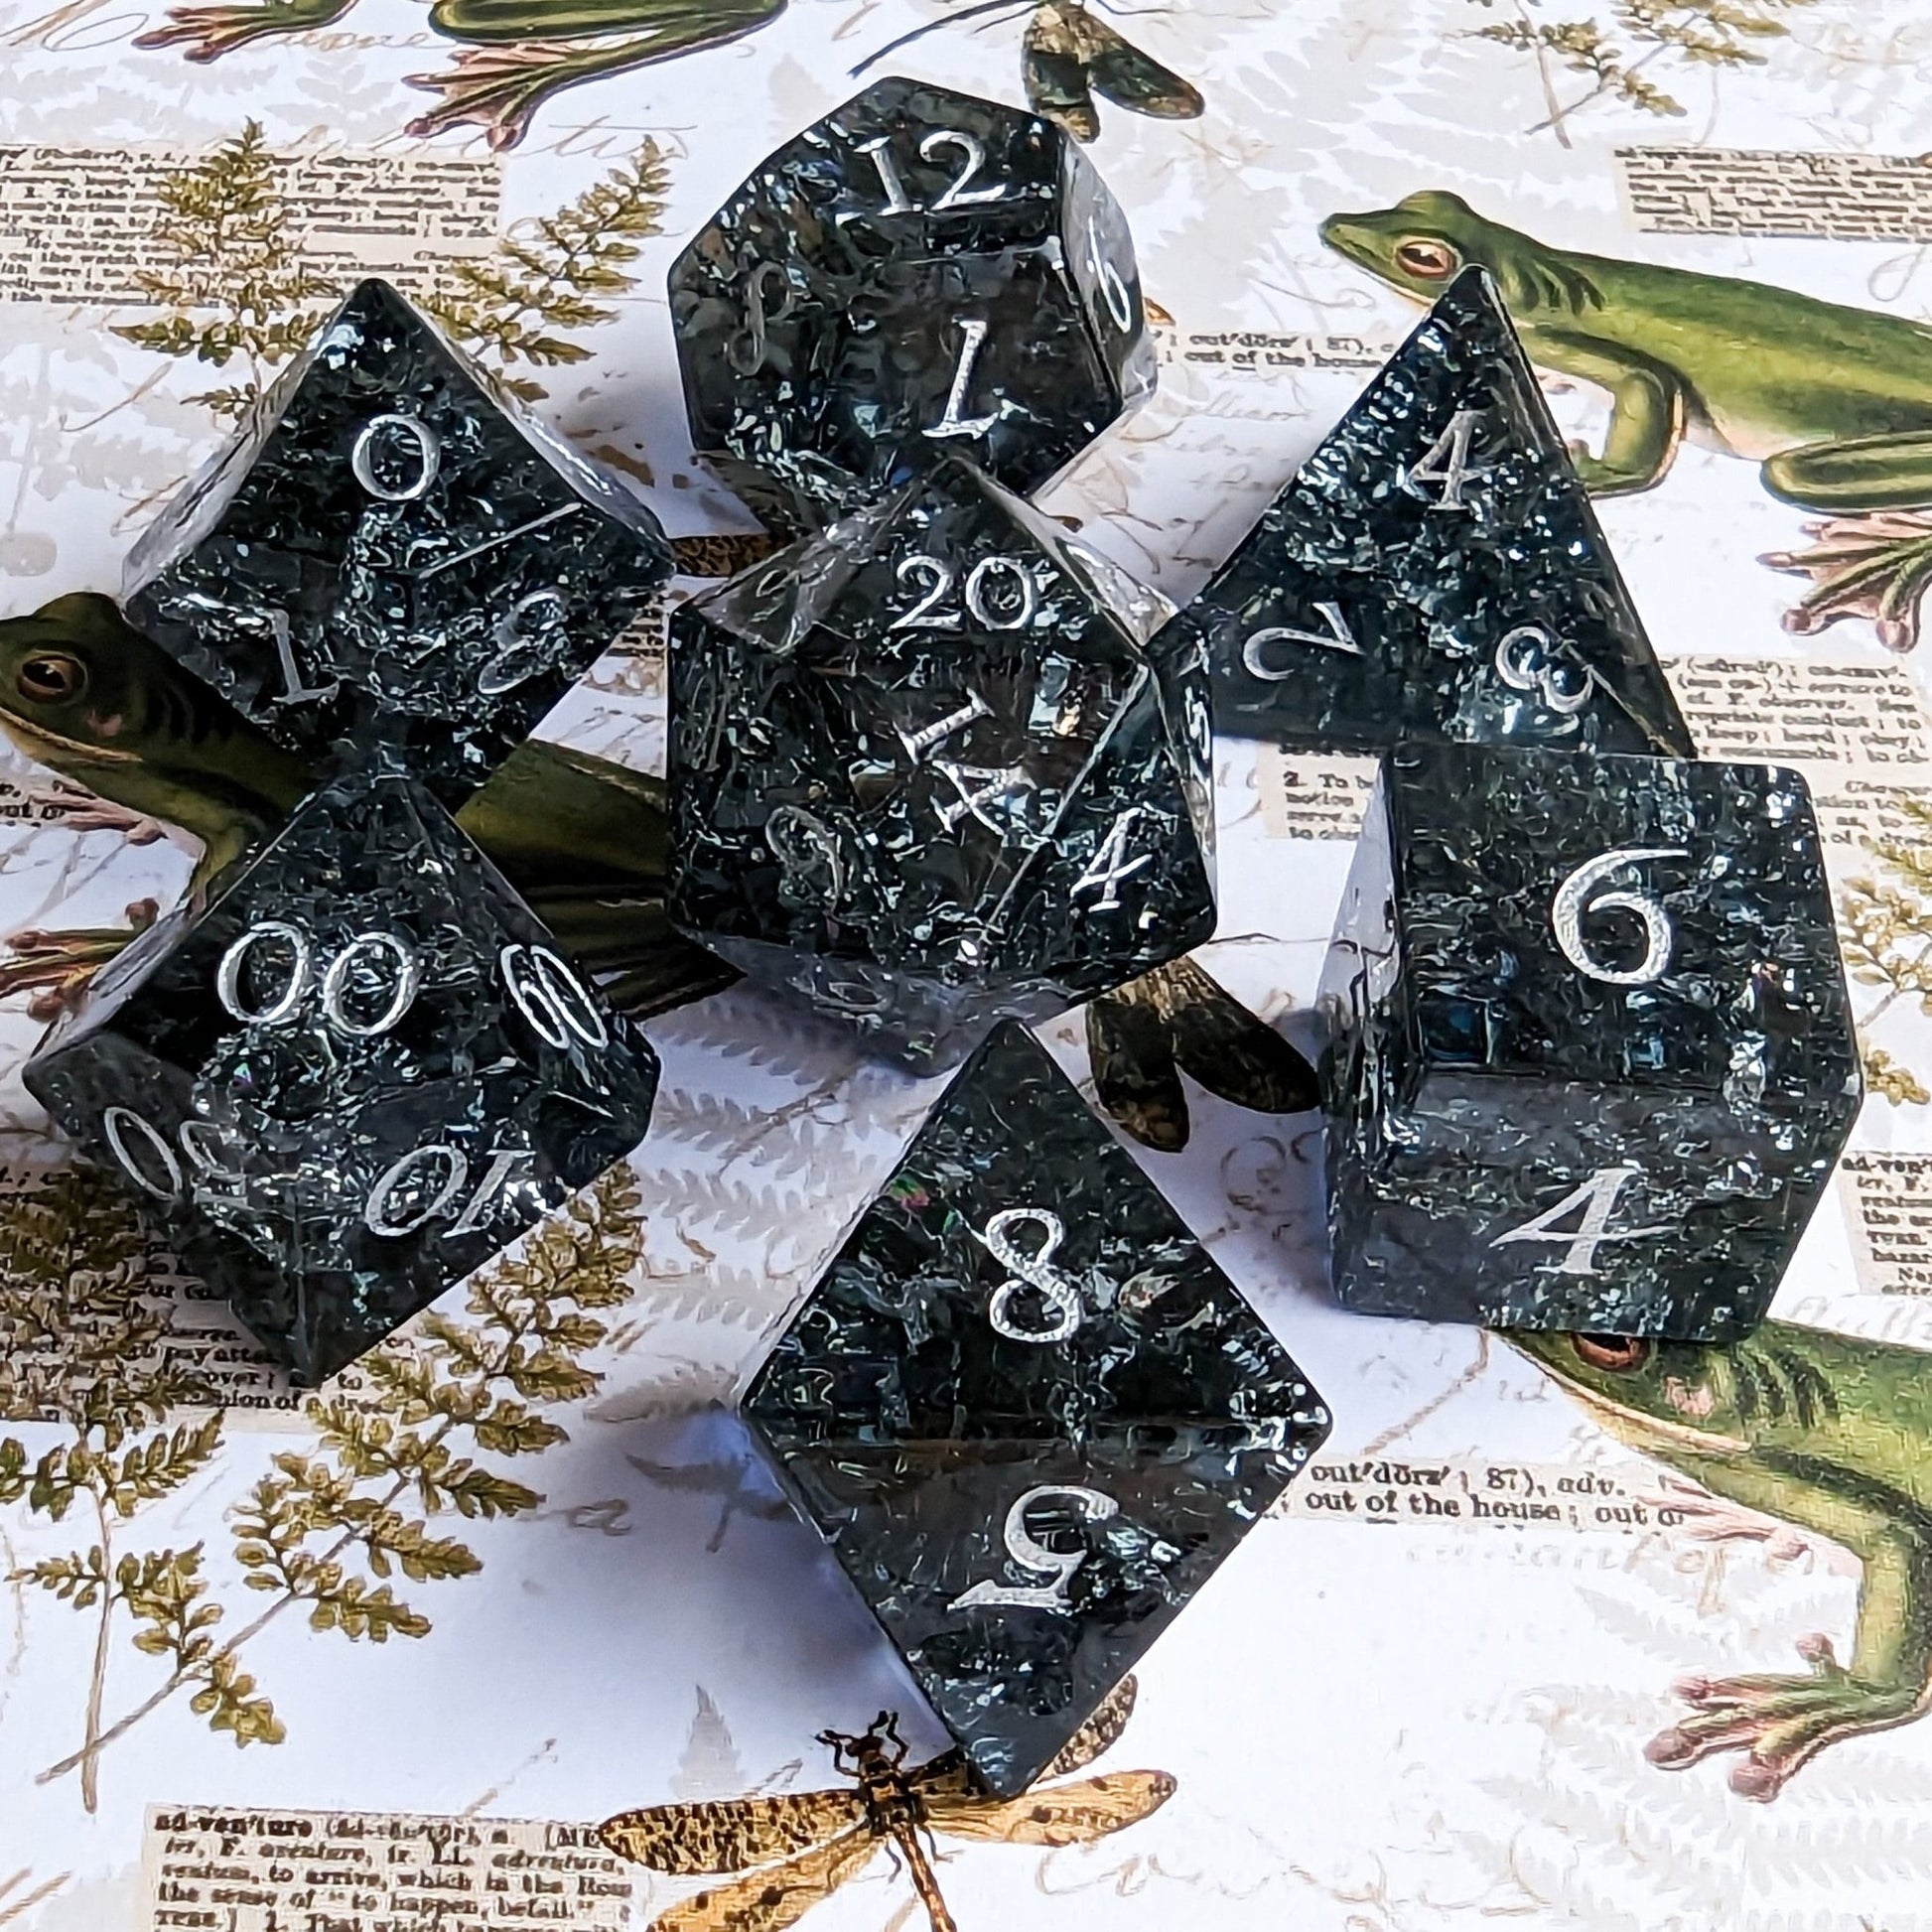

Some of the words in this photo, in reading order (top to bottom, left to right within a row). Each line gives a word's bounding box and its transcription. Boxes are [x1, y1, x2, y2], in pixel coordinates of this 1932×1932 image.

[853, 130, 1007, 216] 12
[351, 413, 440, 500] 0
[1407, 409, 1490, 511] 4
[891, 556, 1037, 631] 20
[1551, 848, 1690, 986] 6
[217, 921, 417, 1035] 00
[1488, 1165, 1678, 1276] 4
[984, 1208, 1079, 1344] 8
[1305, 1489, 1357, 1513] out
[1365, 1489, 1398, 1514] of
[1408, 1491, 1461, 1518] the
[1594, 1502, 1648, 1527] out
